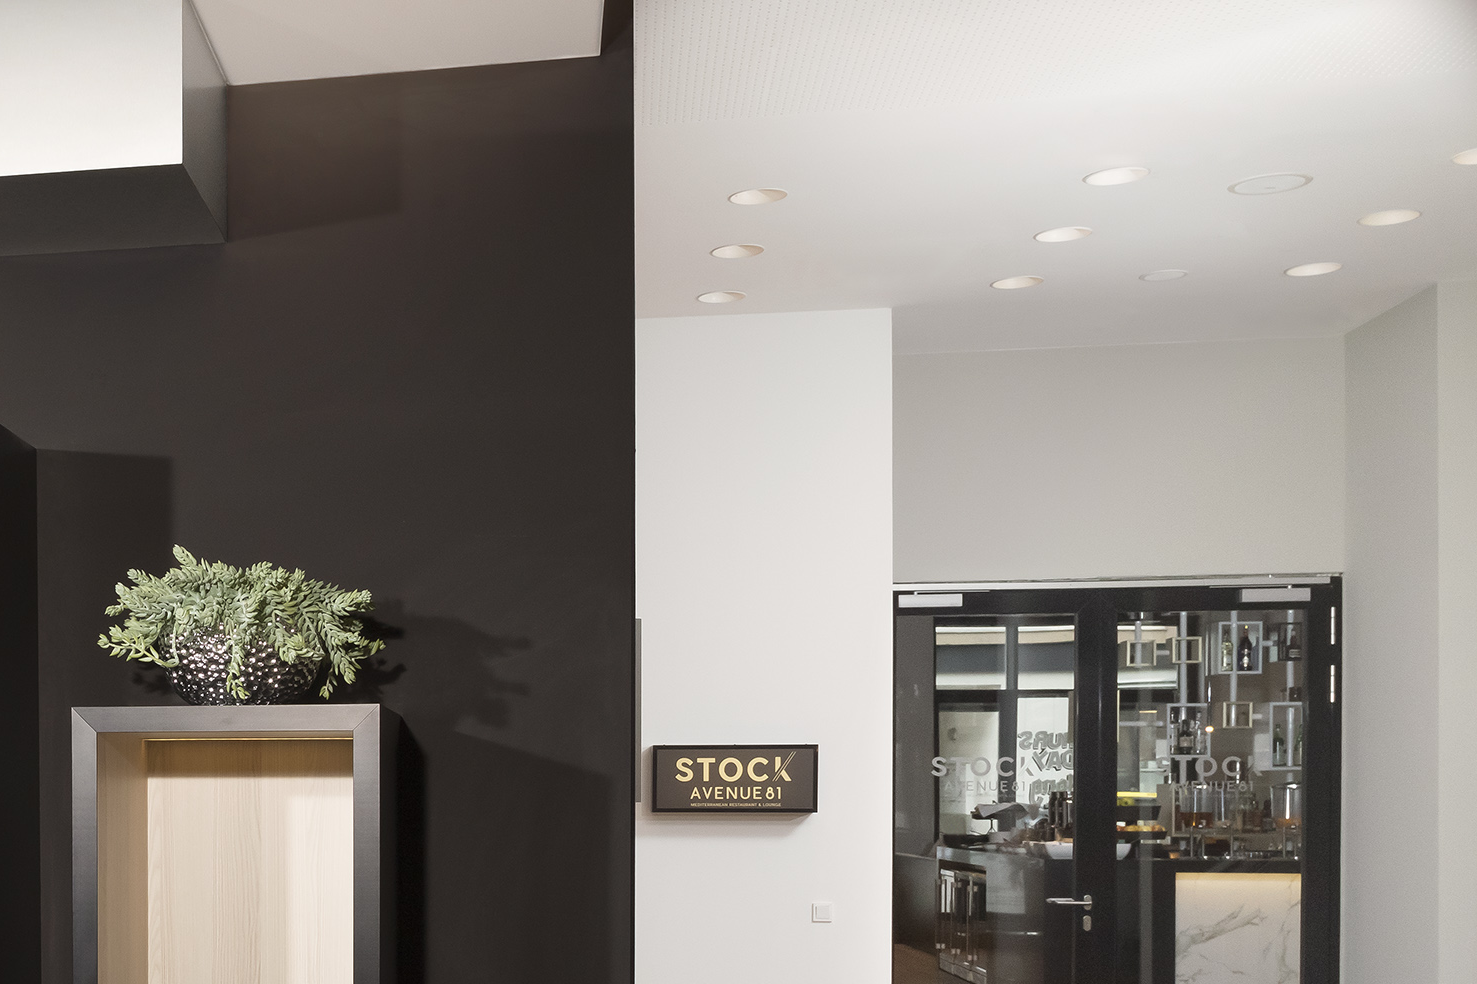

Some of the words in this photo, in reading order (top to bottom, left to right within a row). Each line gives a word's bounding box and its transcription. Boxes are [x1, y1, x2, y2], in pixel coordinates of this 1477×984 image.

[675, 751, 796, 782] STOCK
[931, 756, 1034, 777] STOCK
[1156, 755, 1262, 777] TOCK
[690, 786, 762, 800] AVENUE
[765, 786, 782, 800] 81
[944, 780, 1009, 792] AENUE
